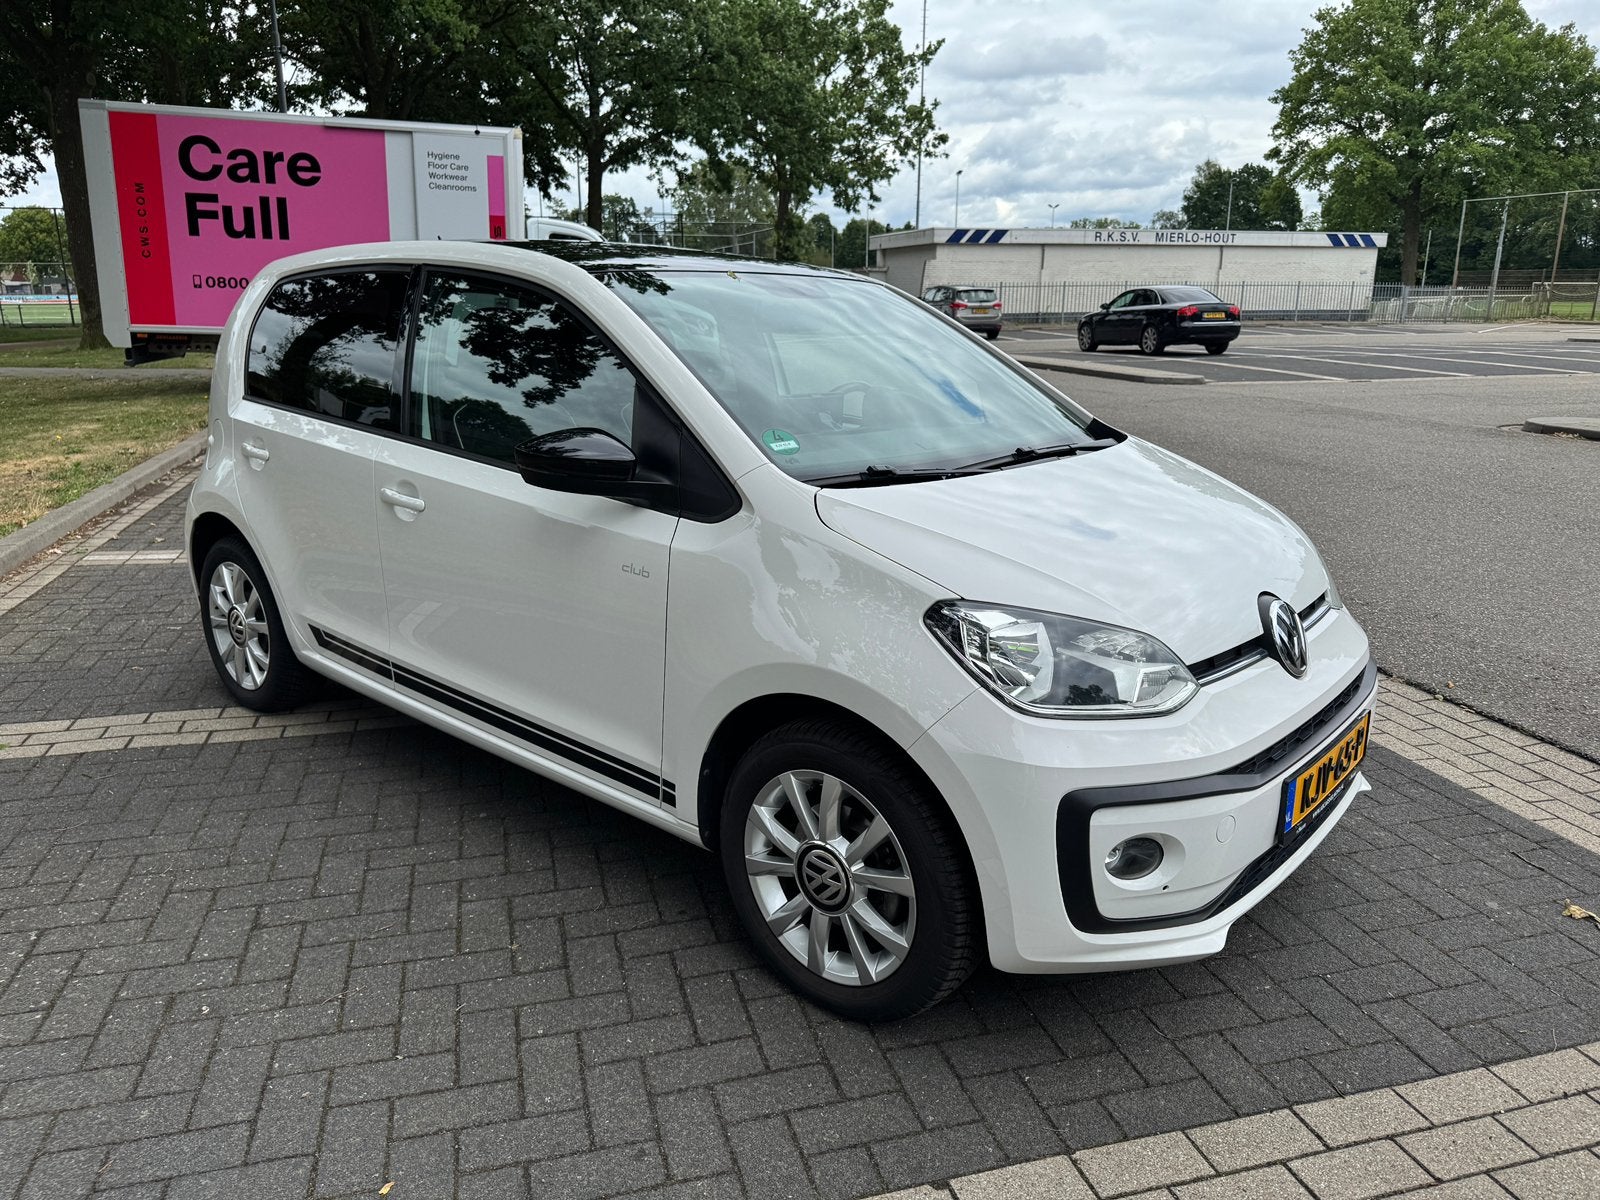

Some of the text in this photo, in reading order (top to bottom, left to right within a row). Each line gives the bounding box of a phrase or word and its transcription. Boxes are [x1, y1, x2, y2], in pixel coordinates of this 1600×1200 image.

[178, 135, 321, 187] Care
[427, 151, 460, 160] Hygiene
[427, 162, 469, 171] Floor Care
[428, 171, 468, 181] Workwear
[428, 182, 477, 192] Cleanrooms
[135, 182, 152, 259] CWS.COM
[184, 192, 290, 240] Full
[1094, 231, 1237, 244] R.K.S.V. MIERLO-HOUT
[205, 276, 250, 289] 0800
[621, 562, 650, 578] club
